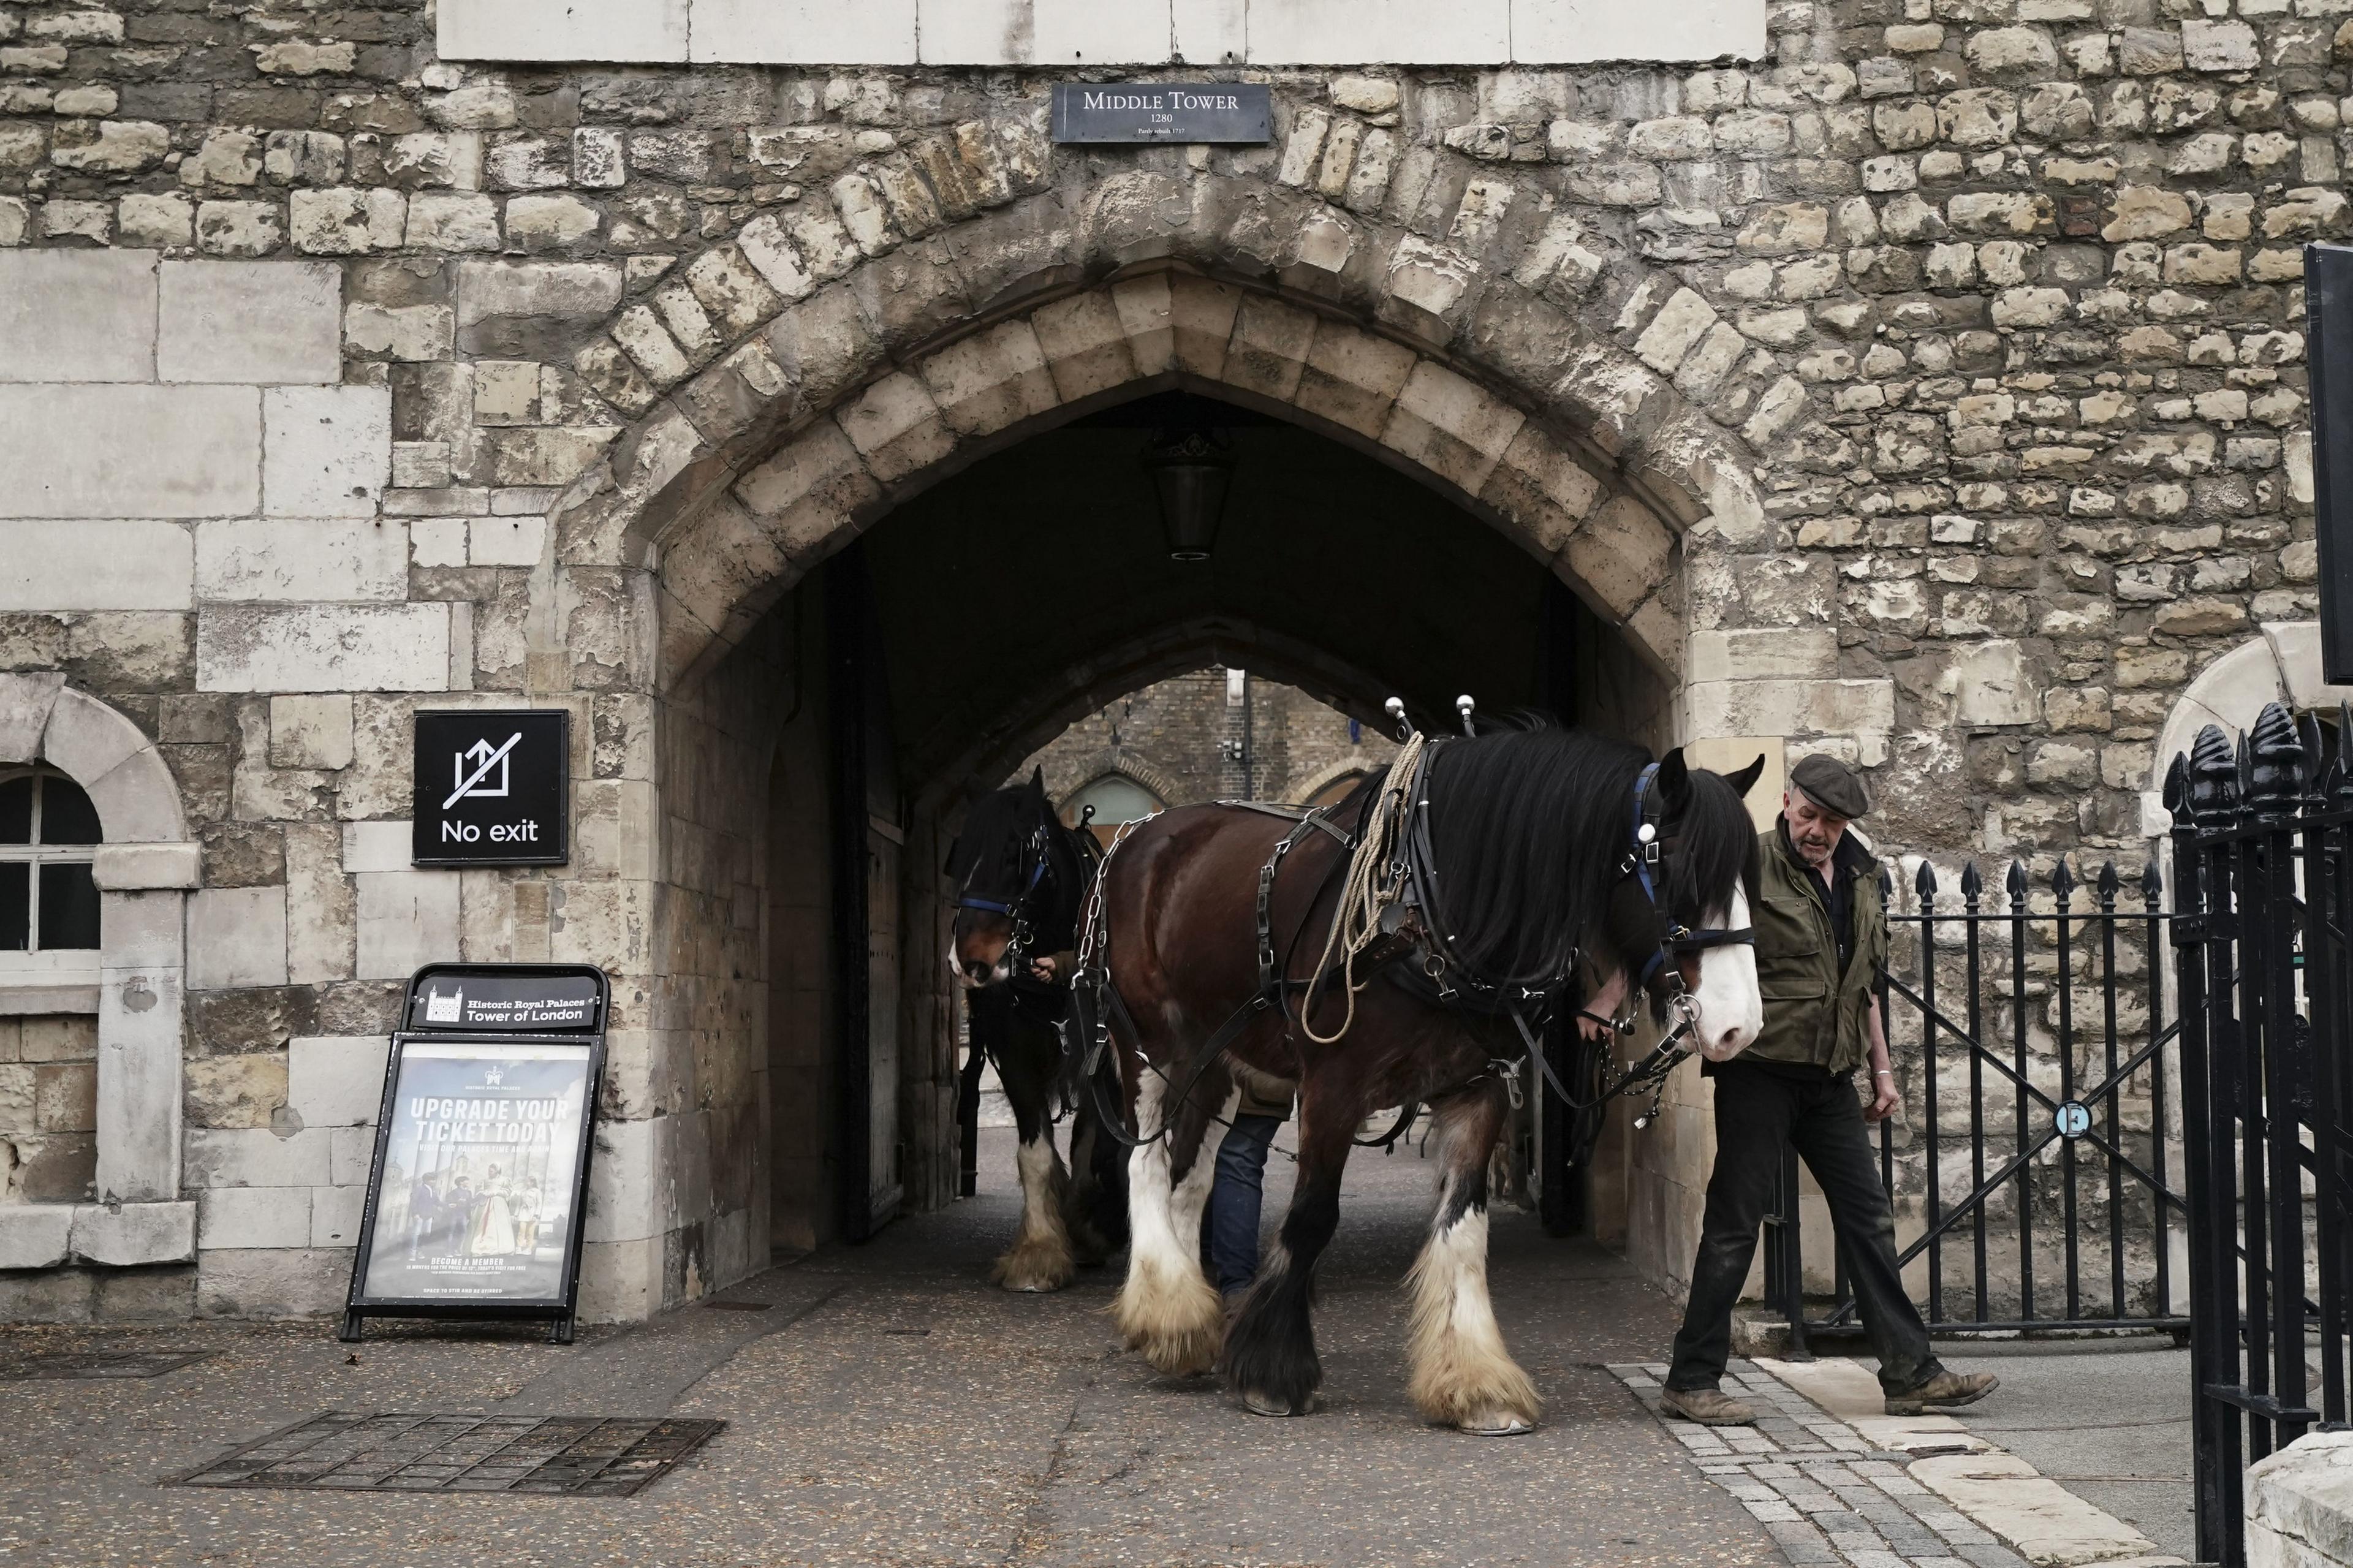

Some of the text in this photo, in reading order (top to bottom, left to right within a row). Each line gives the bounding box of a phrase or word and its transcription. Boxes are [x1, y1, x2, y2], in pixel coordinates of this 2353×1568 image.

[1083, 91, 1239, 110] MIDDLE TOWER
[1151, 113, 1173, 123] 1280
[442, 819, 539, 843] No exit
[468, 999, 585, 1010] Historic Royal Palaces
[467, 1009, 583, 1022] Tower of London
[410, 1097, 569, 1121] UPGRADE YOUR
[2064, 1104, 2086, 1135] E
[415, 1121, 561, 1143] TICKET TODAY
[441, 1144, 455, 1153] OUR
[431, 1257, 462, 1265] BECOME
